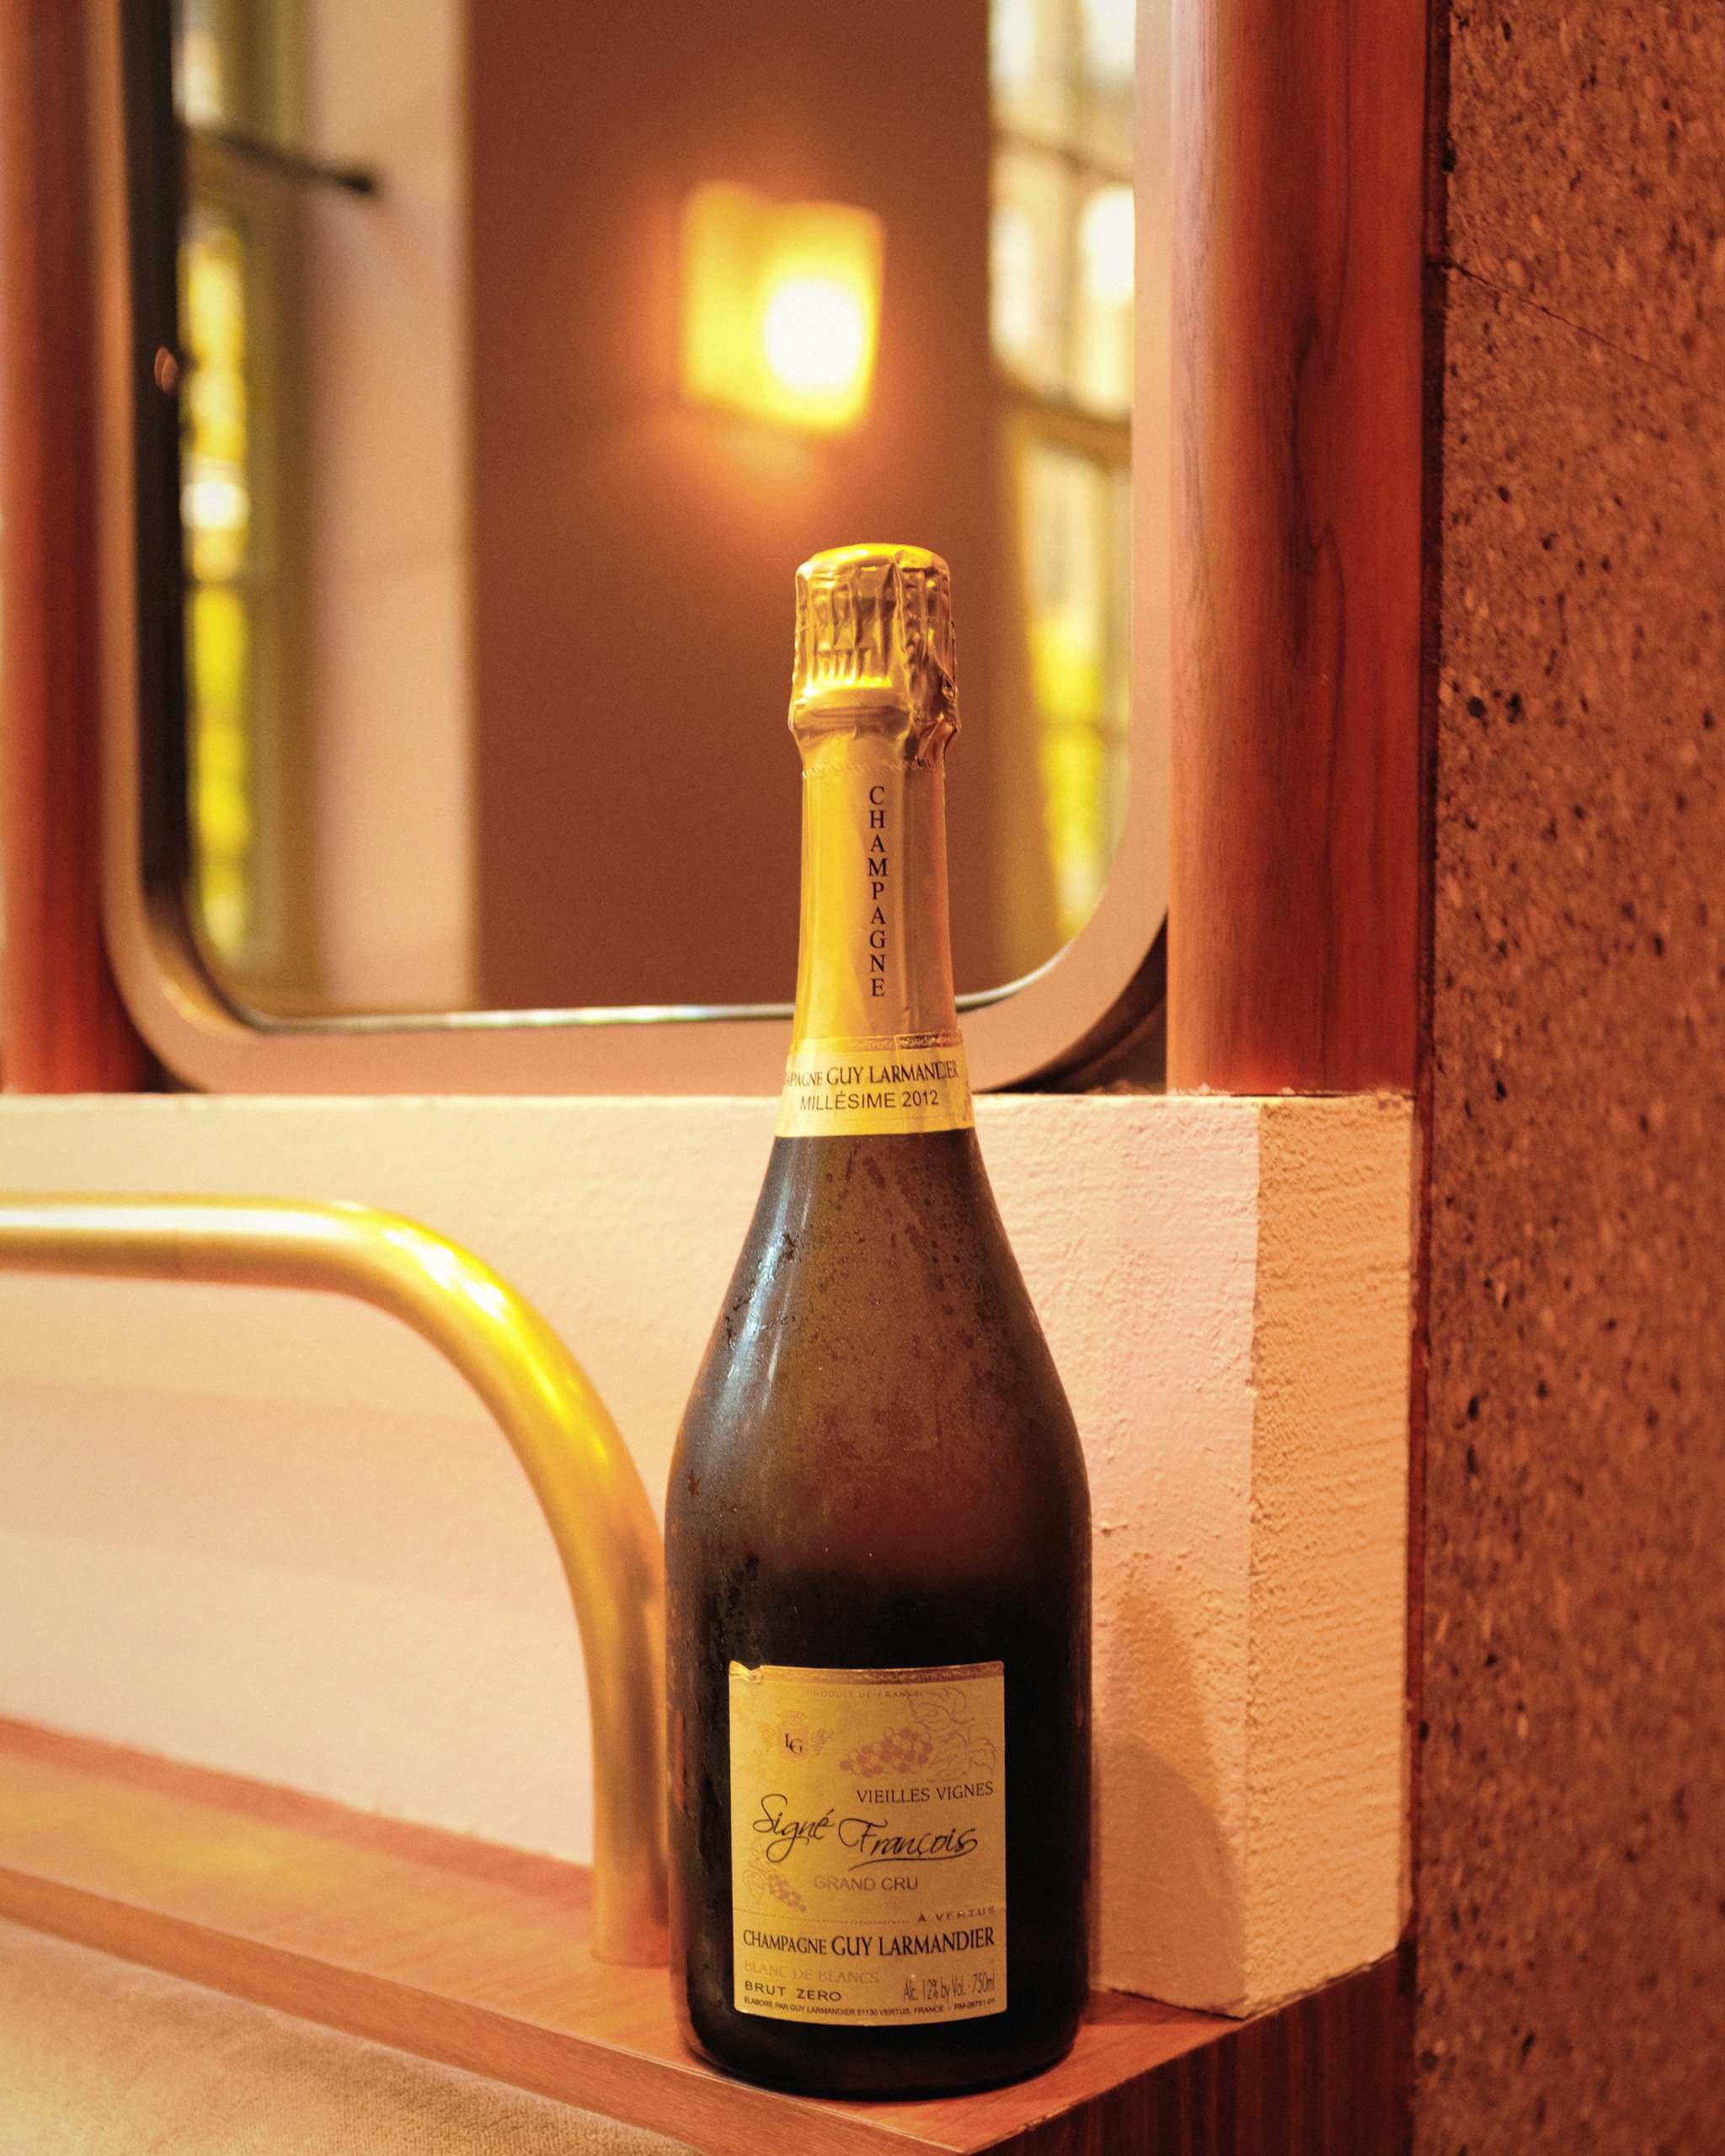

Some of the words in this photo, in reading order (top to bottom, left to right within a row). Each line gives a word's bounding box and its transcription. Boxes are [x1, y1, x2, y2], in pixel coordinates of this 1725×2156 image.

[868, 786, 889, 996] CHAMPAGNE
[826, 1066, 864, 1086] GUY
[868, 1059, 960, 1085] LARMANDIER
[799, 1091, 897, 1111] MILLÉSIME
[901, 1090, 940, 1107] 2012
[856, 1786, 931, 1804] VIEILLES
[936, 1781, 994, 1799] VIGNES
[753, 1793, 835, 1863] Signé
[838, 1817, 978, 1871] François
[813, 1876, 875, 1892] GRAND
[880, 1876, 919, 1892] CRU
[935, 1906, 996, 1921] VERTUS
[743, 1929, 827, 1956] CHAMPAGNE
[831, 1935, 873, 1956] GUY
[879, 1926, 995, 1956] LARMANDIER
[745, 1960, 788, 1978] BLANC
[793, 1966, 812, 1980] DE
[818, 1968, 880, 1984] BLANCS
[745, 1980, 787, 1997] BRUT
[796, 1988, 842, 2002] ZERO
[775, 2001, 789, 2010] PAR
[789, 2004, 806, 2013] GUY
[806, 2007, 855, 2015] LARMANDIER
[857, 2008, 878, 2016] 51130
[914, 2004, 944, 2014] FRANCE
